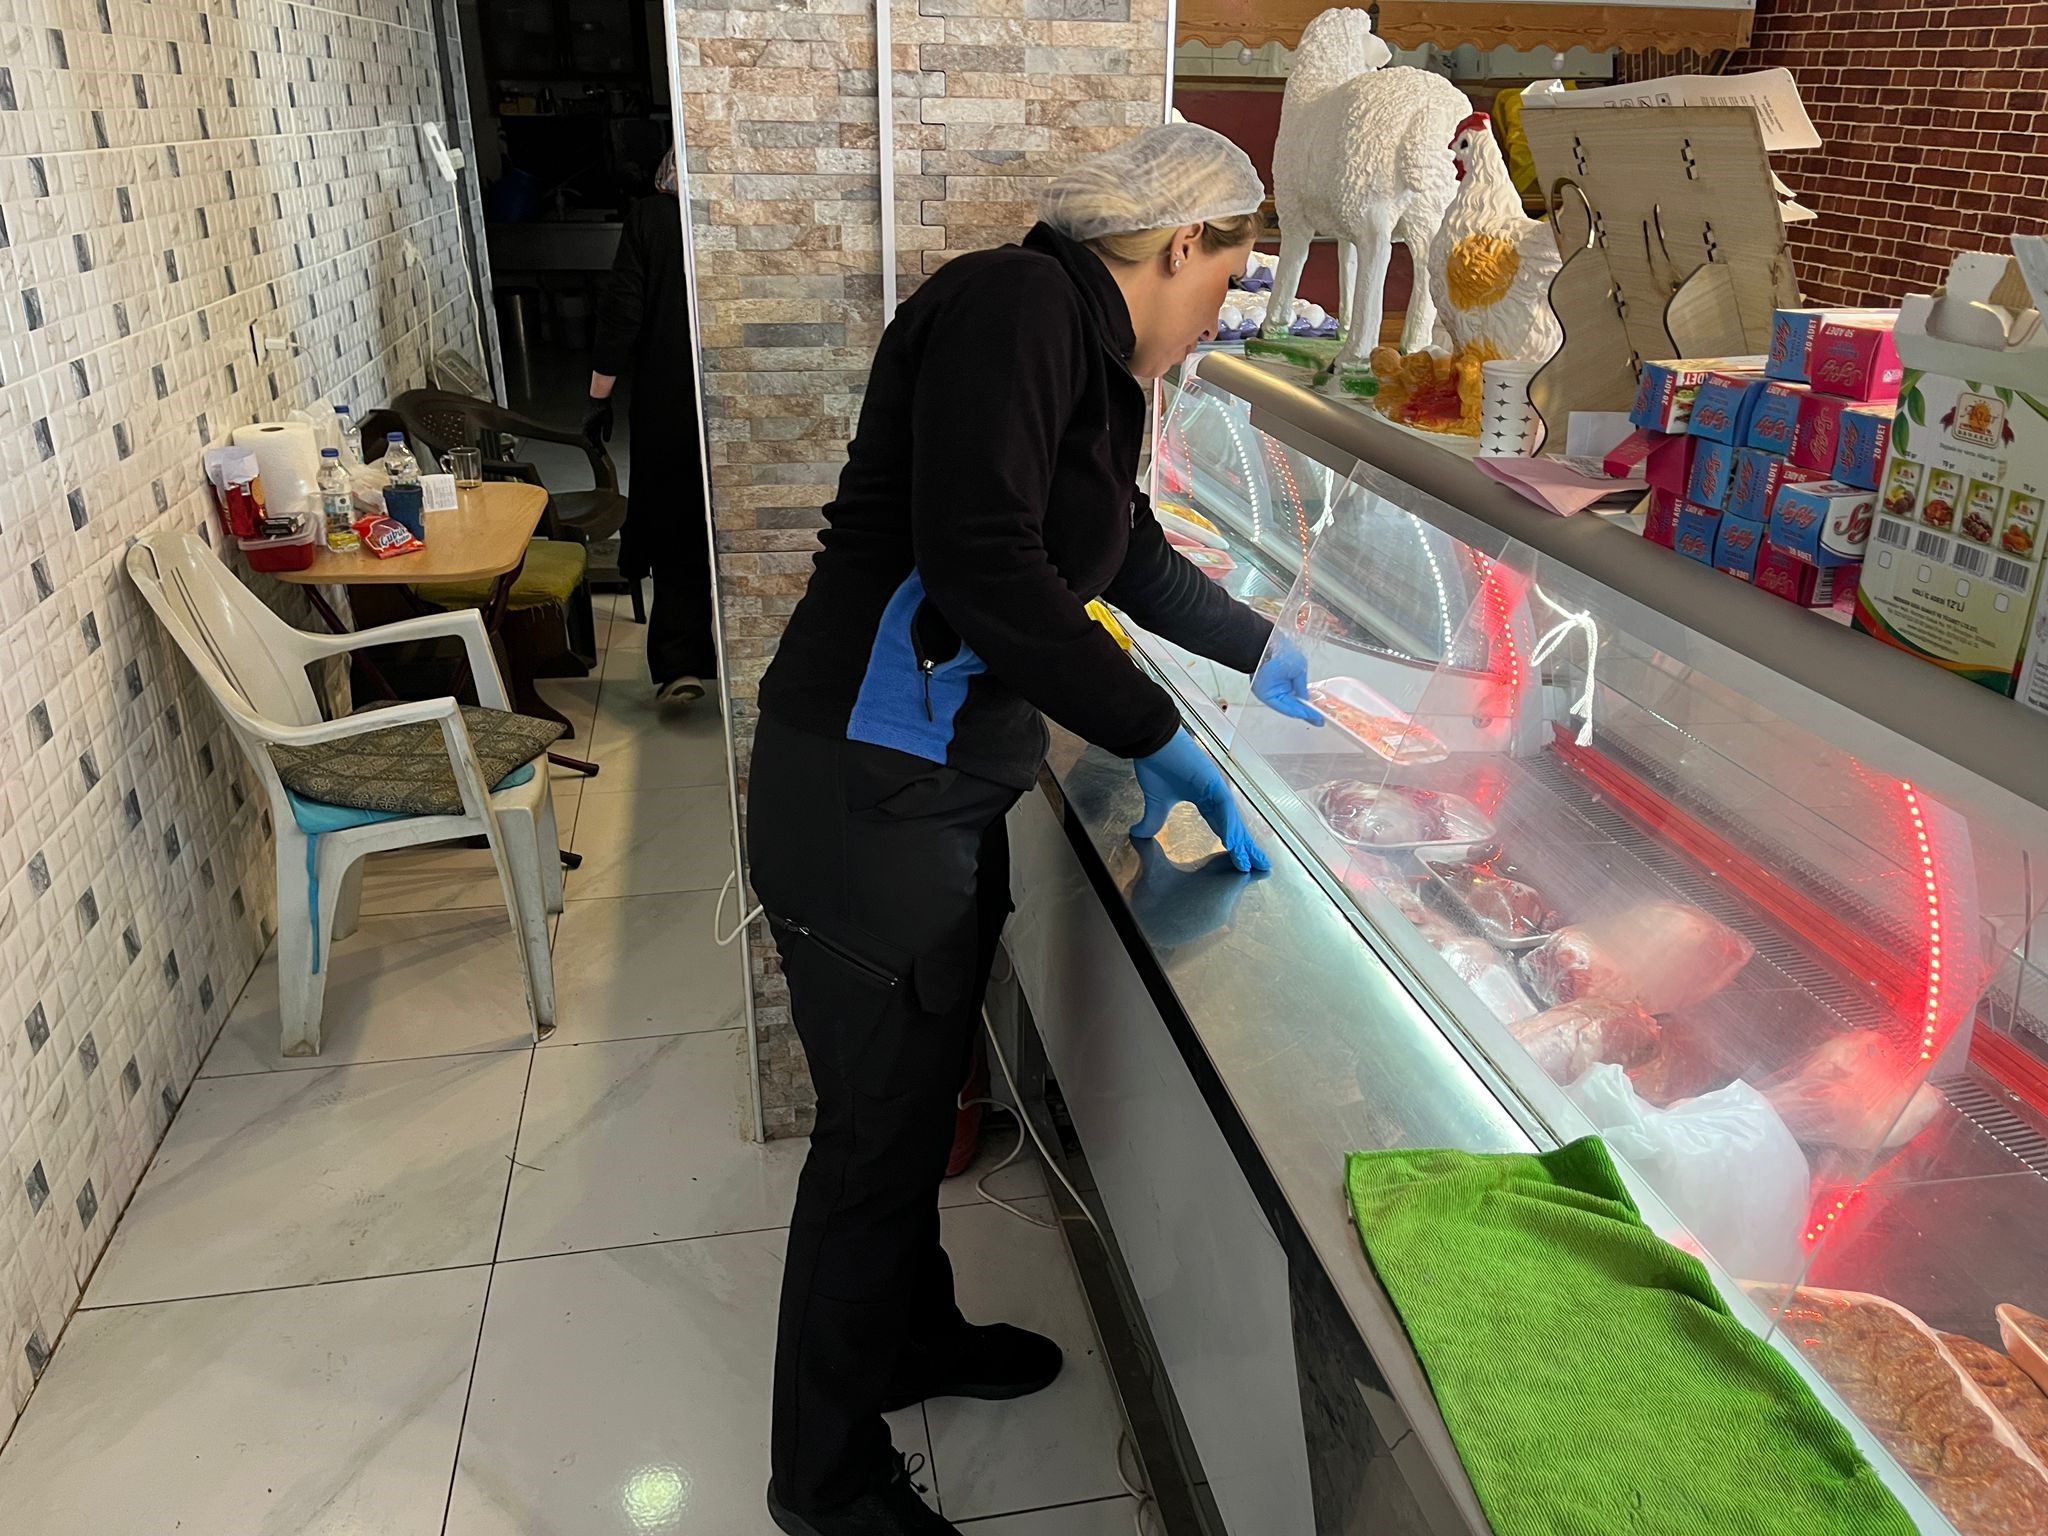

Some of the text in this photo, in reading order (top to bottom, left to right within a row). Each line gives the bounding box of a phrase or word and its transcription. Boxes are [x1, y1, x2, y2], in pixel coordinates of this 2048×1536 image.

[1804, 319, 1818, 352] 20 ADET
[1825, 325, 1855, 338] 50 ADET
[1661, 374, 1674, 405] 20 ADET
[1766, 384, 1781, 396] ADET
[1790, 435, 1799, 457] ADET
[1873, 423, 1887, 459] 20 ADET
[1765, 462, 1779, 495] 20 ADET
[1674, 499, 1683, 518] ADET
[1797, 548, 1812, 561] ADET
